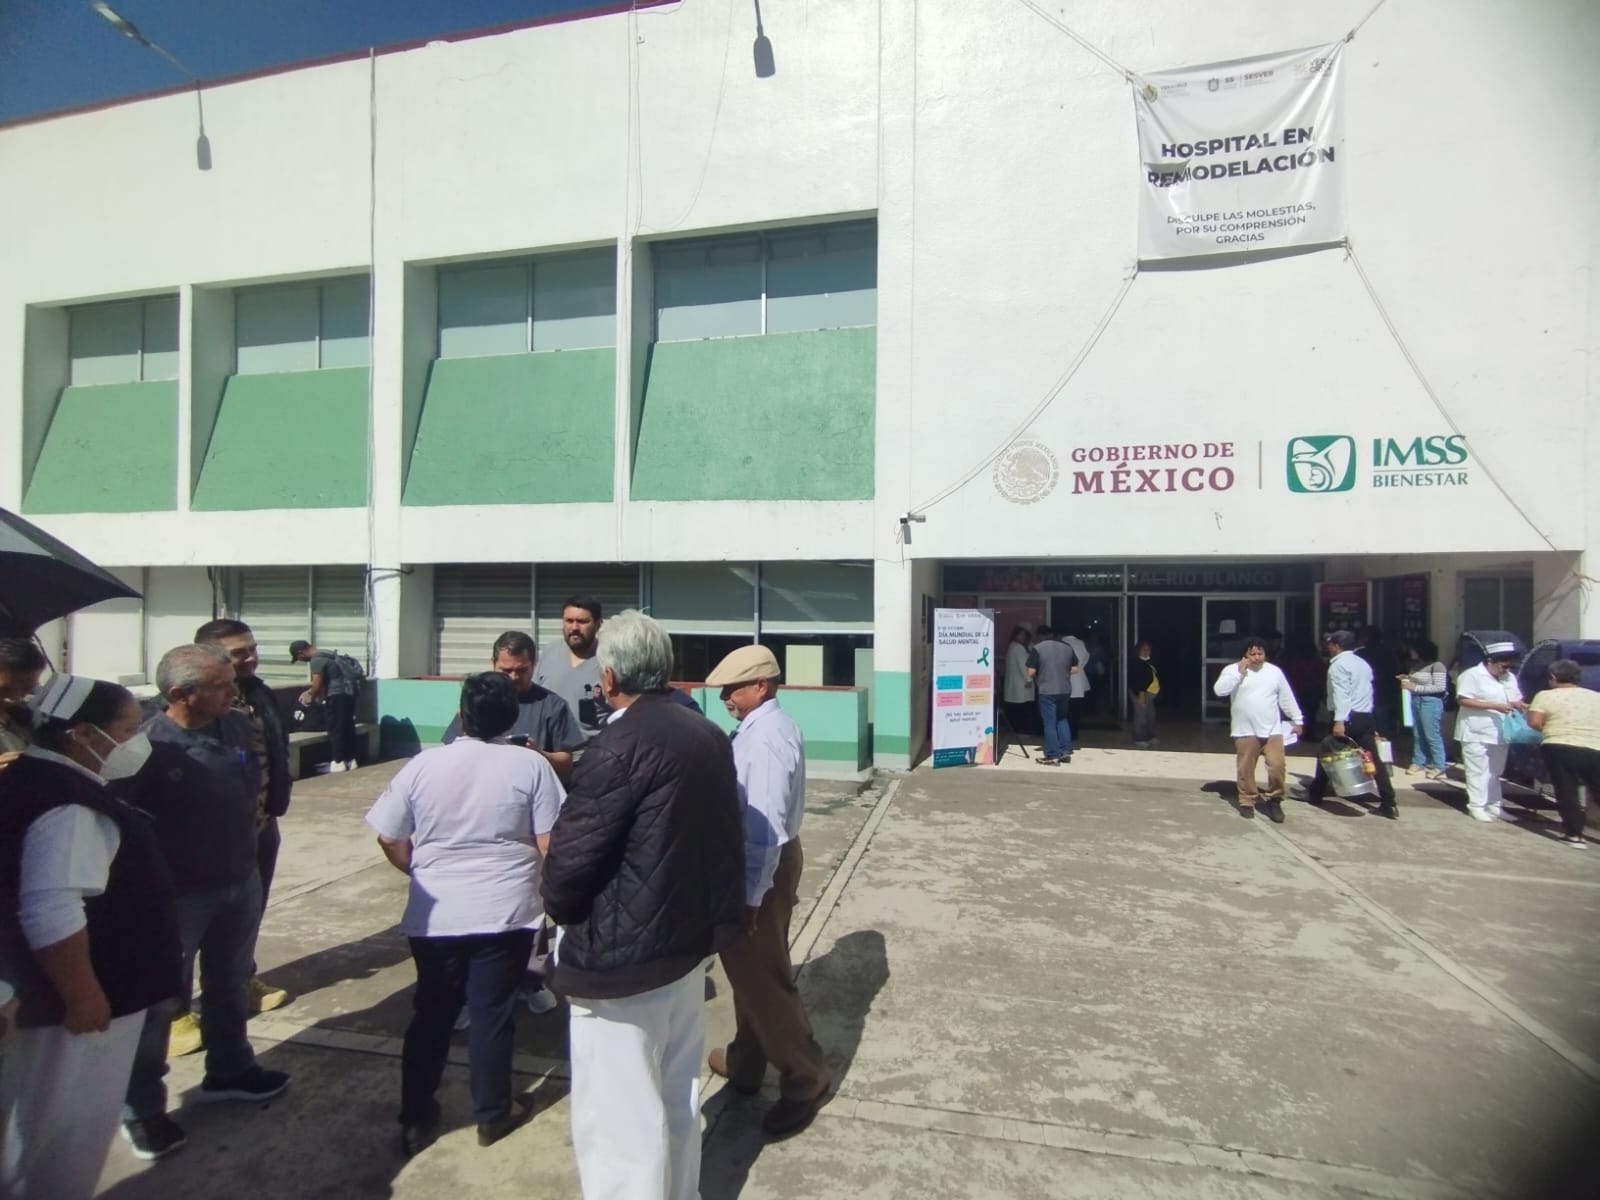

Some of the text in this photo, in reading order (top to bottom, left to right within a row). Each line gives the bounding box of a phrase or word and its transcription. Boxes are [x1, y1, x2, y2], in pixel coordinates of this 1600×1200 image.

[1161, 126, 1314, 158] HOSPITAL EN
[1148, 144, 1335, 188] REMODELACIÓN
[1223, 210, 1244, 221] LAS
[1246, 202, 1317, 219] MOLESTIAS,
[1176, 215, 1306, 235] POR SU COMPRENSIÓN
[1216, 233, 1265, 244] GRACIAS
[1072, 442, 1234, 463] GOBIERNO DE
[1373, 434, 1468, 467] IMSS
[1072, 462, 1235, 495] MÉXICO
[1373, 472, 1469, 488] BIENESTAR
